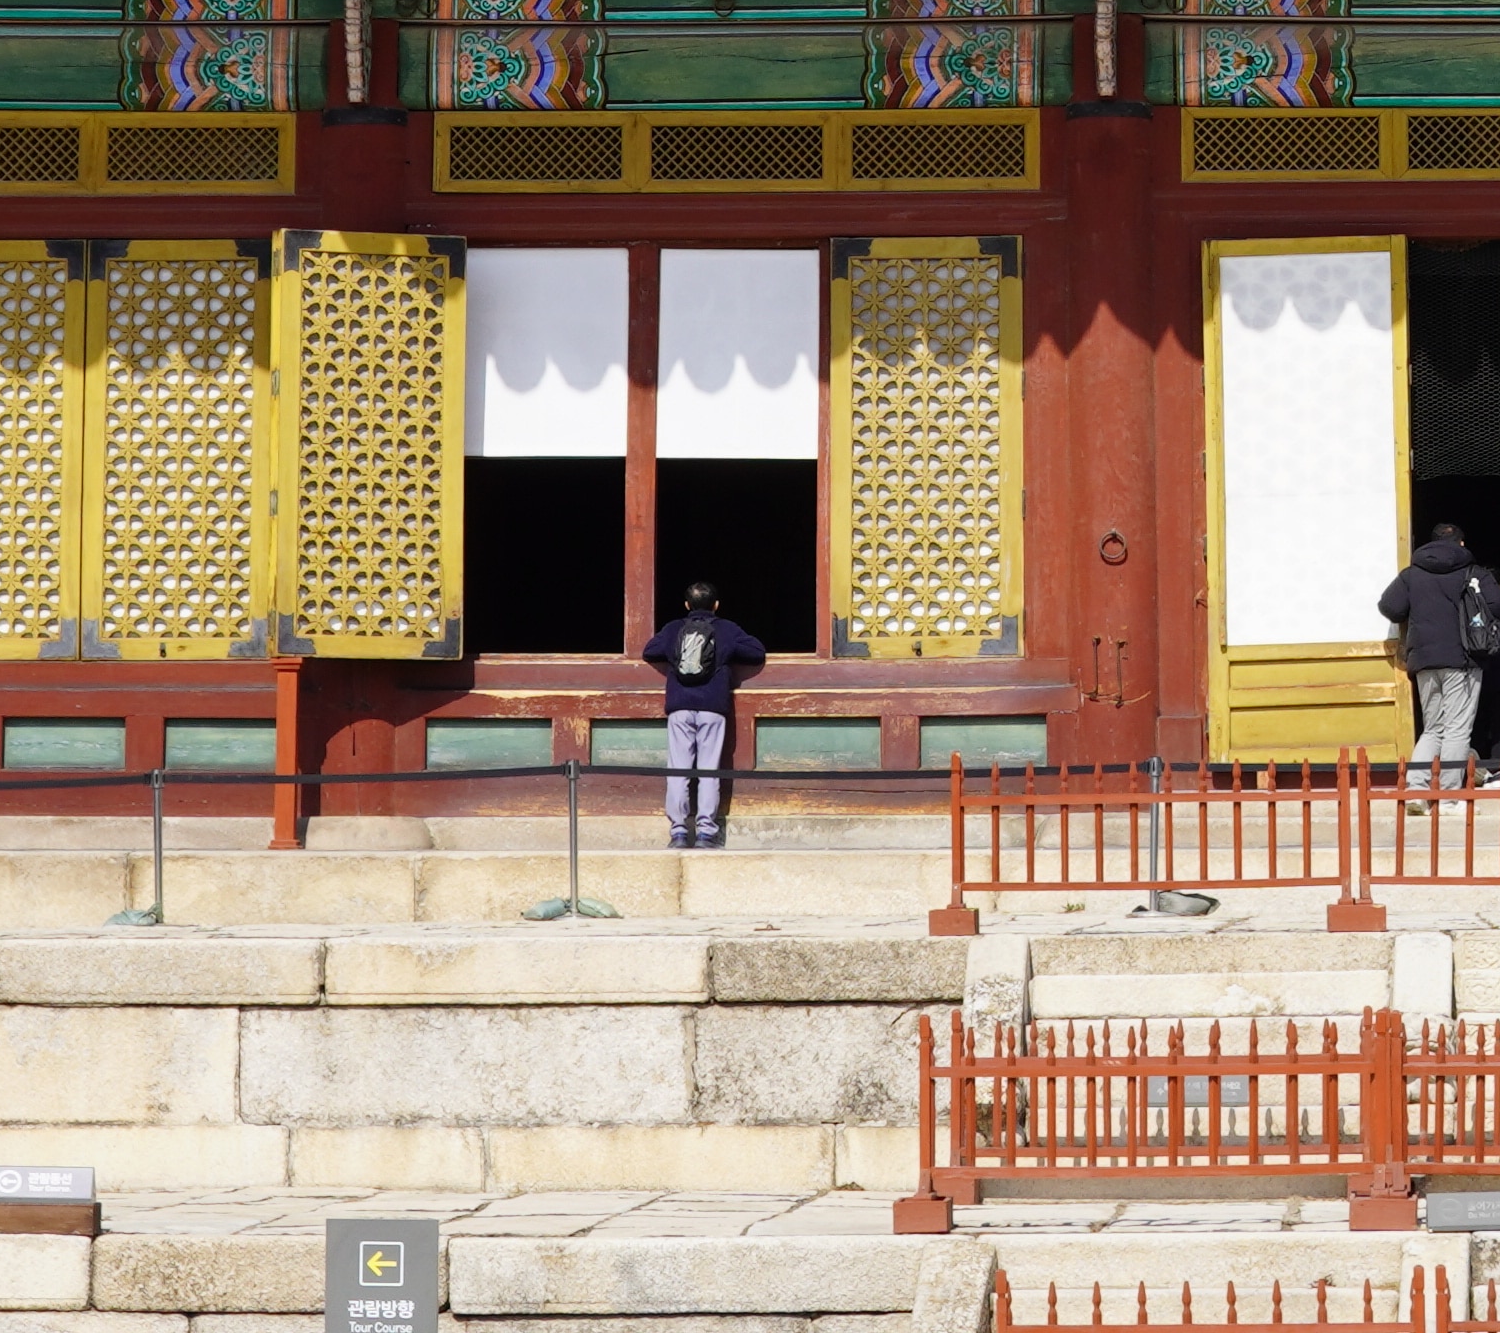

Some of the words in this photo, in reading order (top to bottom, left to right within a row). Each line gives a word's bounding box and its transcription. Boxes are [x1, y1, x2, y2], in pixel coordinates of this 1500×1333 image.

[348, 1299, 415, 1319] 관람방향
[348, 1320, 373, 1333] Tour
[374, 1320, 413, 1333] Course
